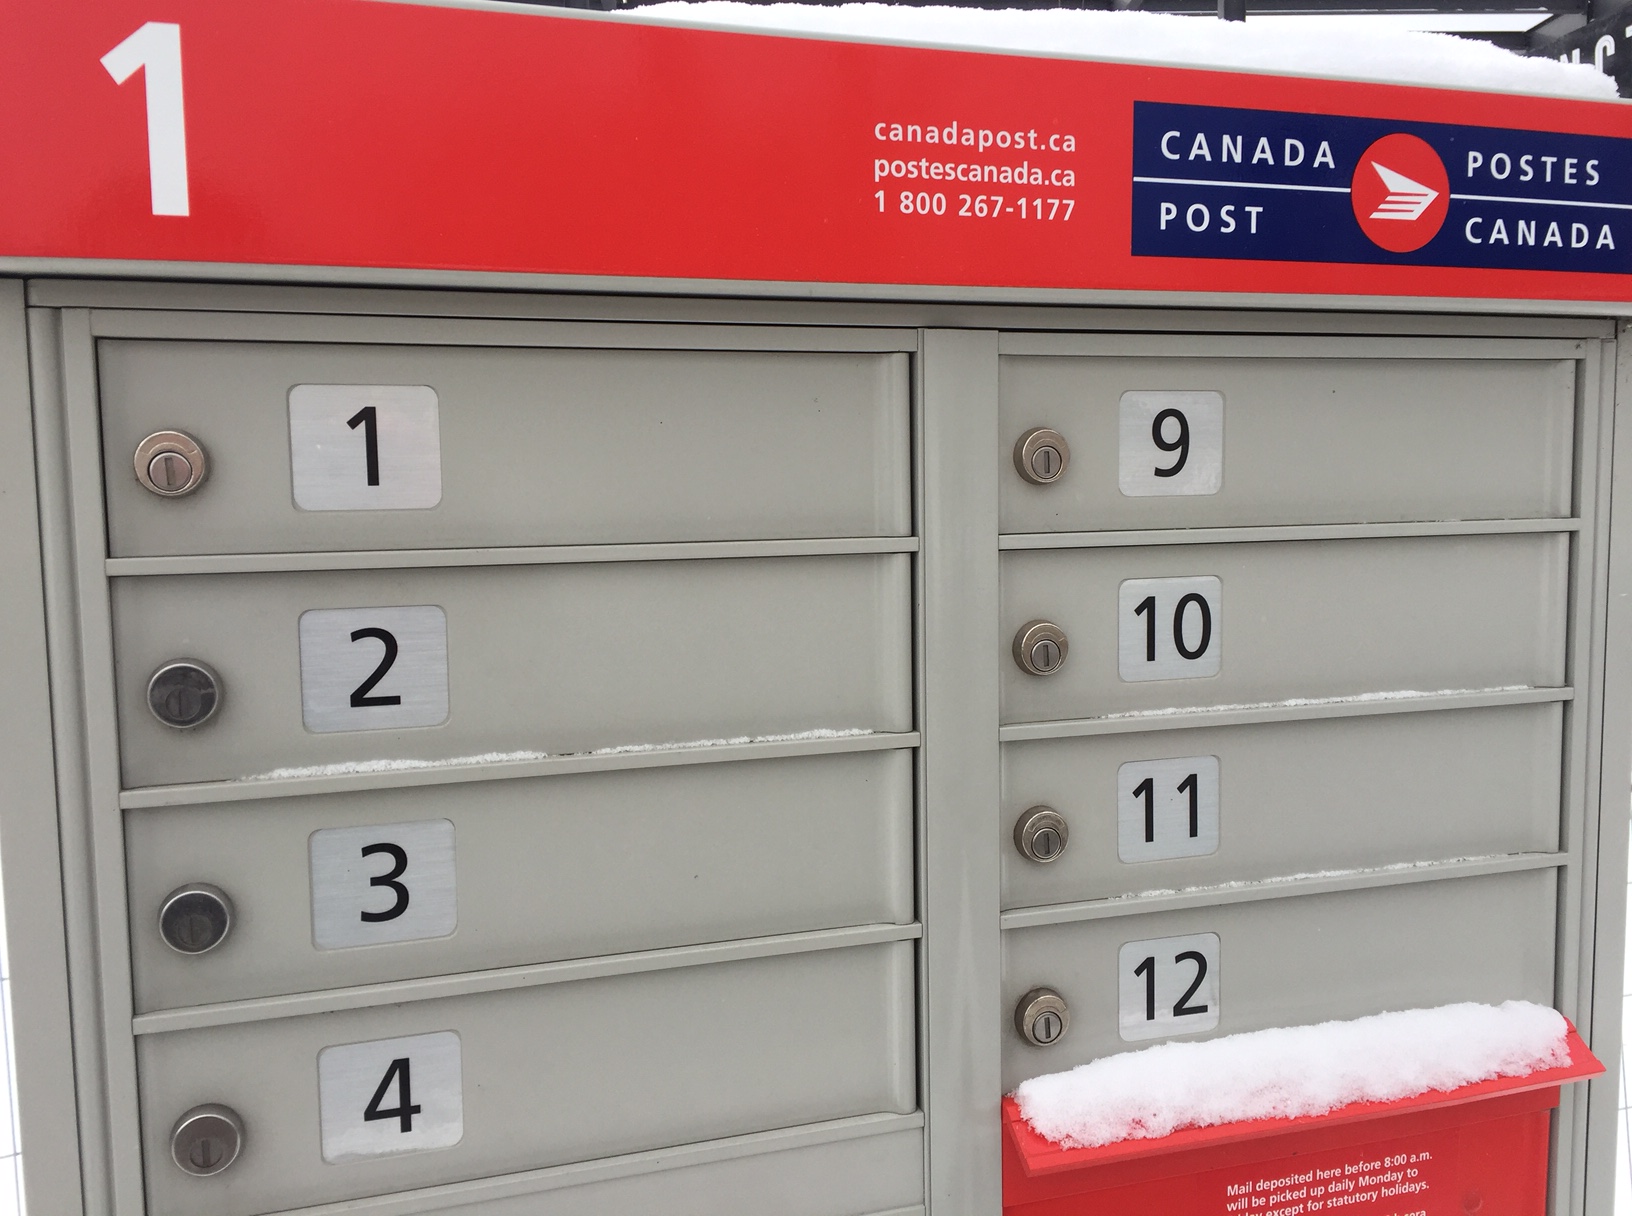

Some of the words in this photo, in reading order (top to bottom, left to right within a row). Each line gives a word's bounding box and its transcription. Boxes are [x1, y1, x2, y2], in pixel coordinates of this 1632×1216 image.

[100, 22, 189, 216] 1
[875, 121, 1075, 152] canadapost.ca
[875, 158, 1075, 186] postescanada.ca
[1161, 131, 1335, 168] CANADA
[1468, 151, 1599, 185] POSTES
[875, 190, 884, 212] 1
[900, 191, 946, 215] 800
[959, 194, 1074, 220] 267-1177
[1161, 203, 1263, 233] POST
[1466, 218, 1614, 249] CANADA
[347, 407, 379, 486] 1
[1152, 409, 1189, 477] 9
[1134, 593, 1211, 661] 10
[350, 628, 401, 707] 2
[1133, 774, 1197, 842] 11
[361, 843, 409, 922] 3
[1134, 951, 1207, 1020] 12
[364, 1058, 420, 1132] 4
[1226, 1197, 1248, 1212] will
[1251, 1196, 1266, 1207] be
[1269, 1186, 1307, 1206] picked
[1310, 1186, 1325, 1197] up
[1327, 1179, 1355, 1193] daily
[1358, 1169, 1403, 1187] Monday
[1406, 1166, 1419, 1177] to
[1227, 1180, 1252, 1196] Mail
[1255, 1170, 1313, 1191] deposited
[1316, 1169, 1341, 1180] here
[1345, 1159, 1381, 1175] before
[1384, 1154, 1407, 1167] 8:00
[1409, 1151, 1433, 1163] a.m.
[1307, 1200, 1324, 1212] for
[1326, 1190, 1378, 1209] statutory
[1381, 1182, 1430, 1198] holidays.
